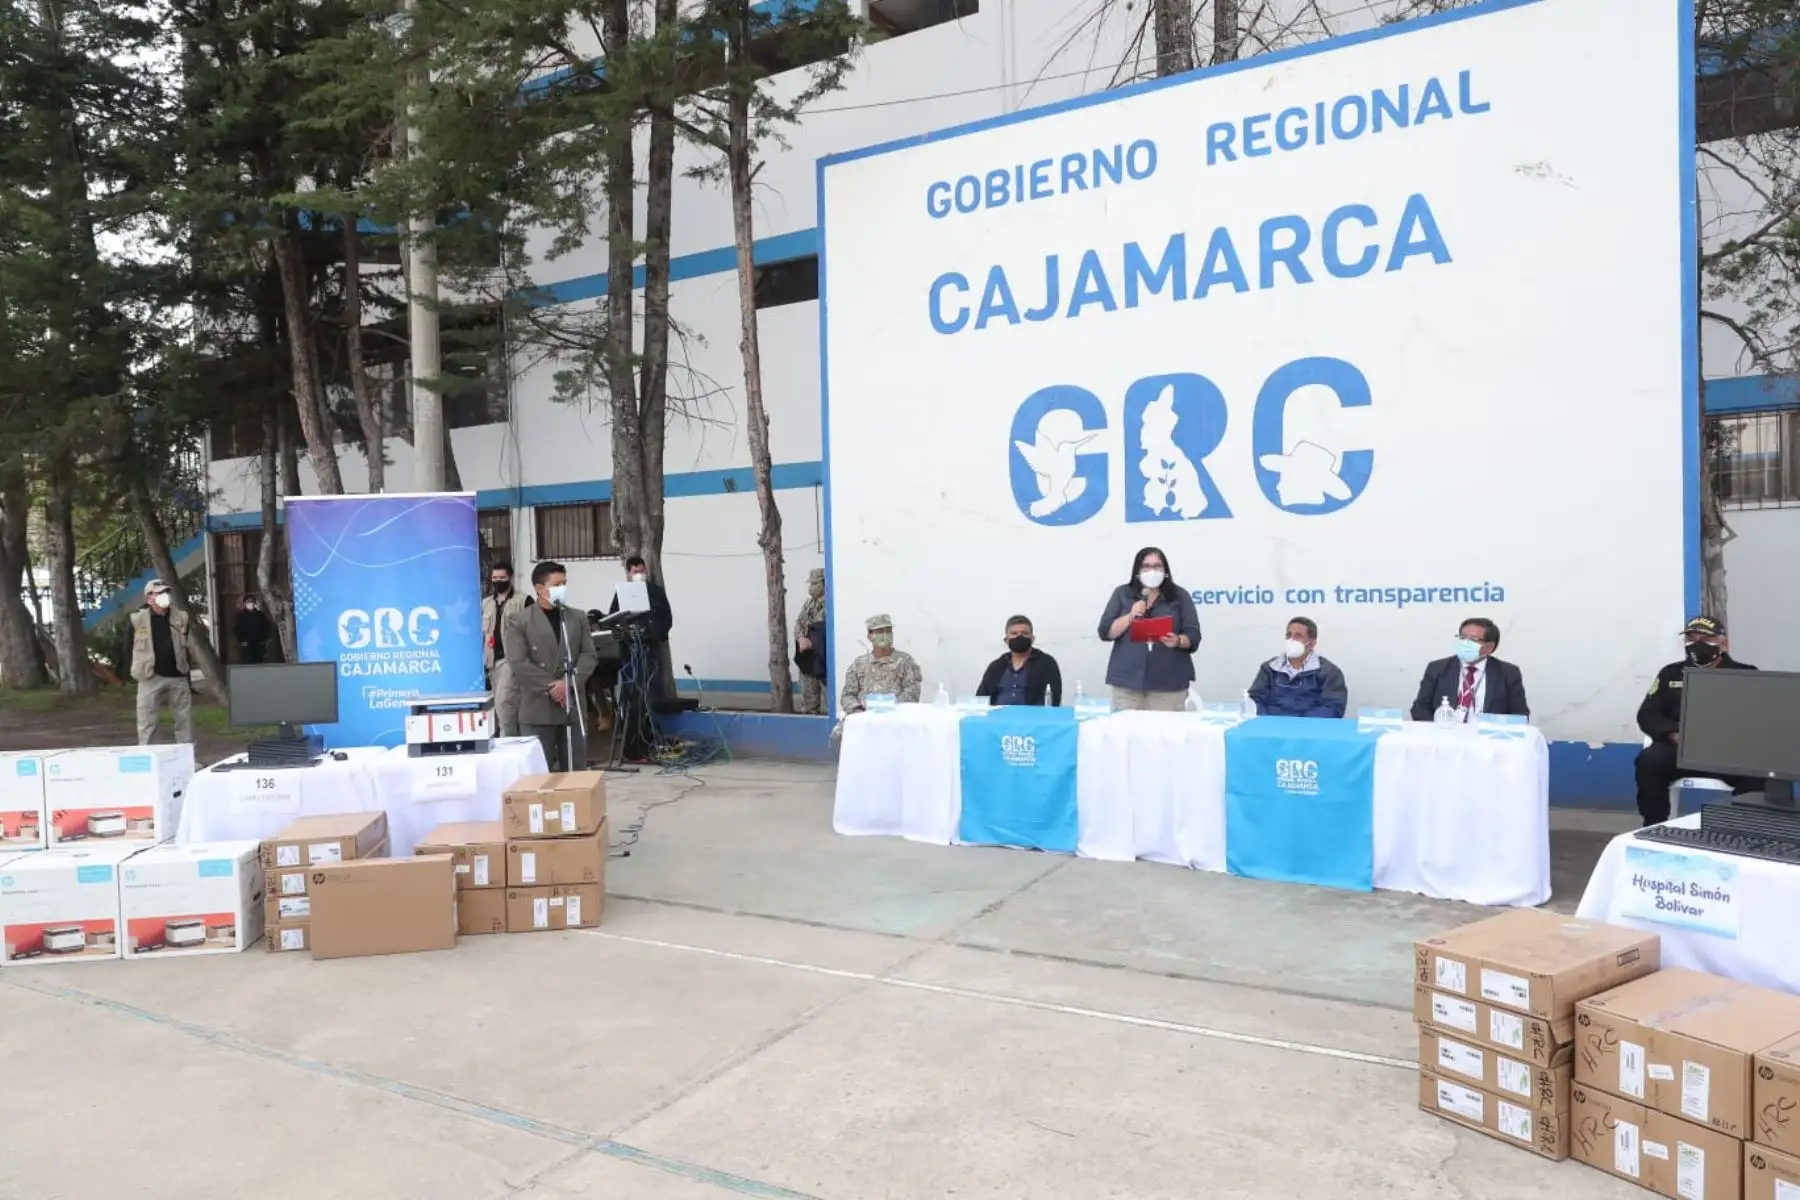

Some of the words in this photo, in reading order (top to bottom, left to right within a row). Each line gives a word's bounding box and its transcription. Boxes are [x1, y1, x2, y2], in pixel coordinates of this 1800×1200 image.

[926, 138, 1158, 219] GOBIERNO
[1205, 70, 1491, 166] REGIONAL
[928, 193, 1453, 335] CAJAMARCA
[1009, 356, 1374, 526] GRC
[1191, 585, 1274, 605] servicio
[1285, 589, 1325, 604] con
[1335, 581, 1504, 608] transparencia
[338, 606, 440, 649] GRC
[340, 652, 390, 662] GOBIERNO
[393, 649, 441, 659] REGIONAL
[341, 660, 441, 676] CAJAMARCA
[1001, 735, 1036, 751] GRC
[436, 766, 454, 777] 131
[1276, 758, 1318, 778] GRC
[256, 778, 275, 789] 136
[1632, 873, 1686, 896] Hospital
[1690, 882, 1730, 903] Simón
[1581, 1028, 1619, 1073] HRC
[1574, 1111, 1619, 1156] HRC
[1758, 1096, 1797, 1142] HRC
